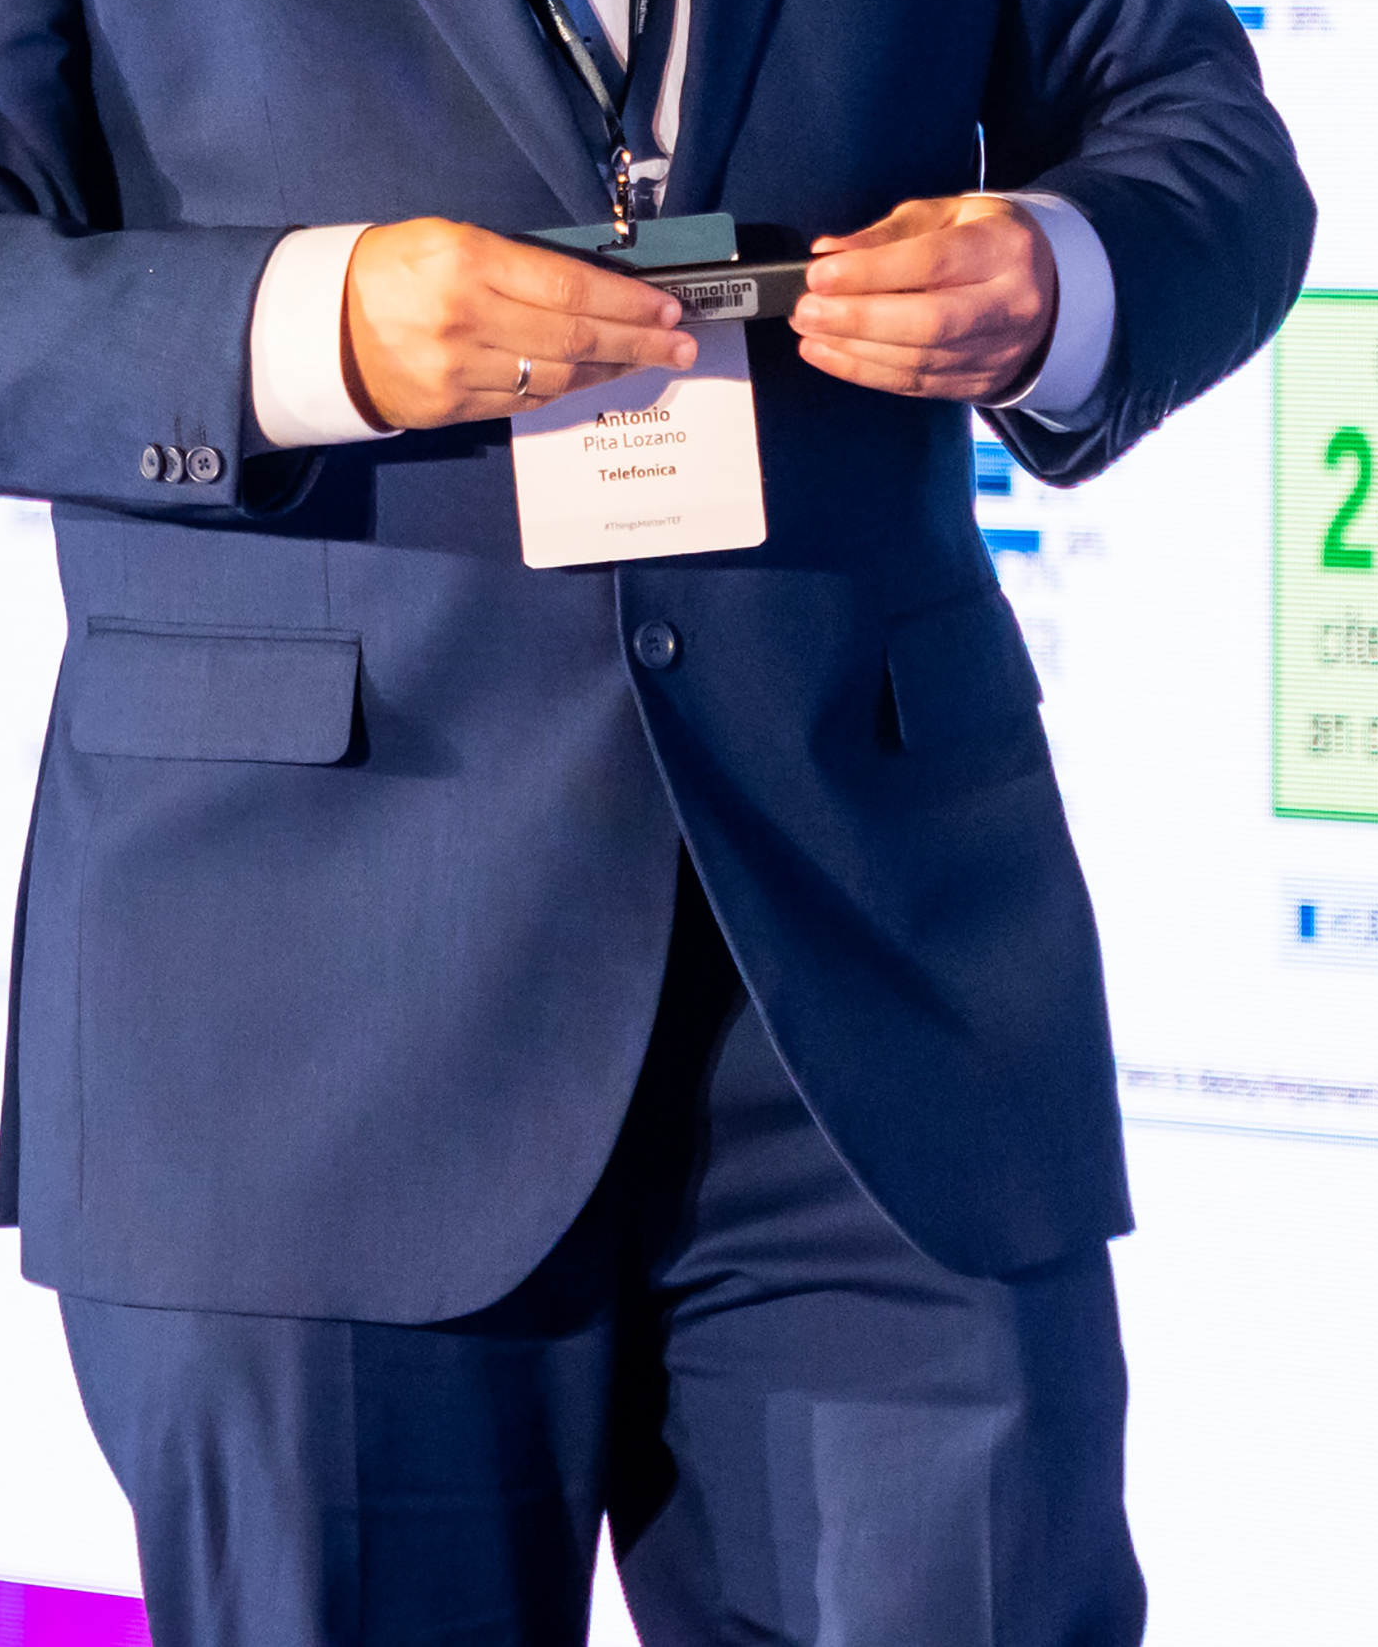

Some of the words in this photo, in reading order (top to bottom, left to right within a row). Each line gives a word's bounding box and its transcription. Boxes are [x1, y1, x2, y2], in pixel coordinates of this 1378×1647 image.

[596, 406, 670, 428] Antonio
[584, 435, 618, 452] Pita
[623, 431, 687, 449] Lozano
[598, 464, 677, 482] Telefonica
[604, 515, 682, 531] #ThingsMatterTEF
[1307, 712, 1352, 758] an
